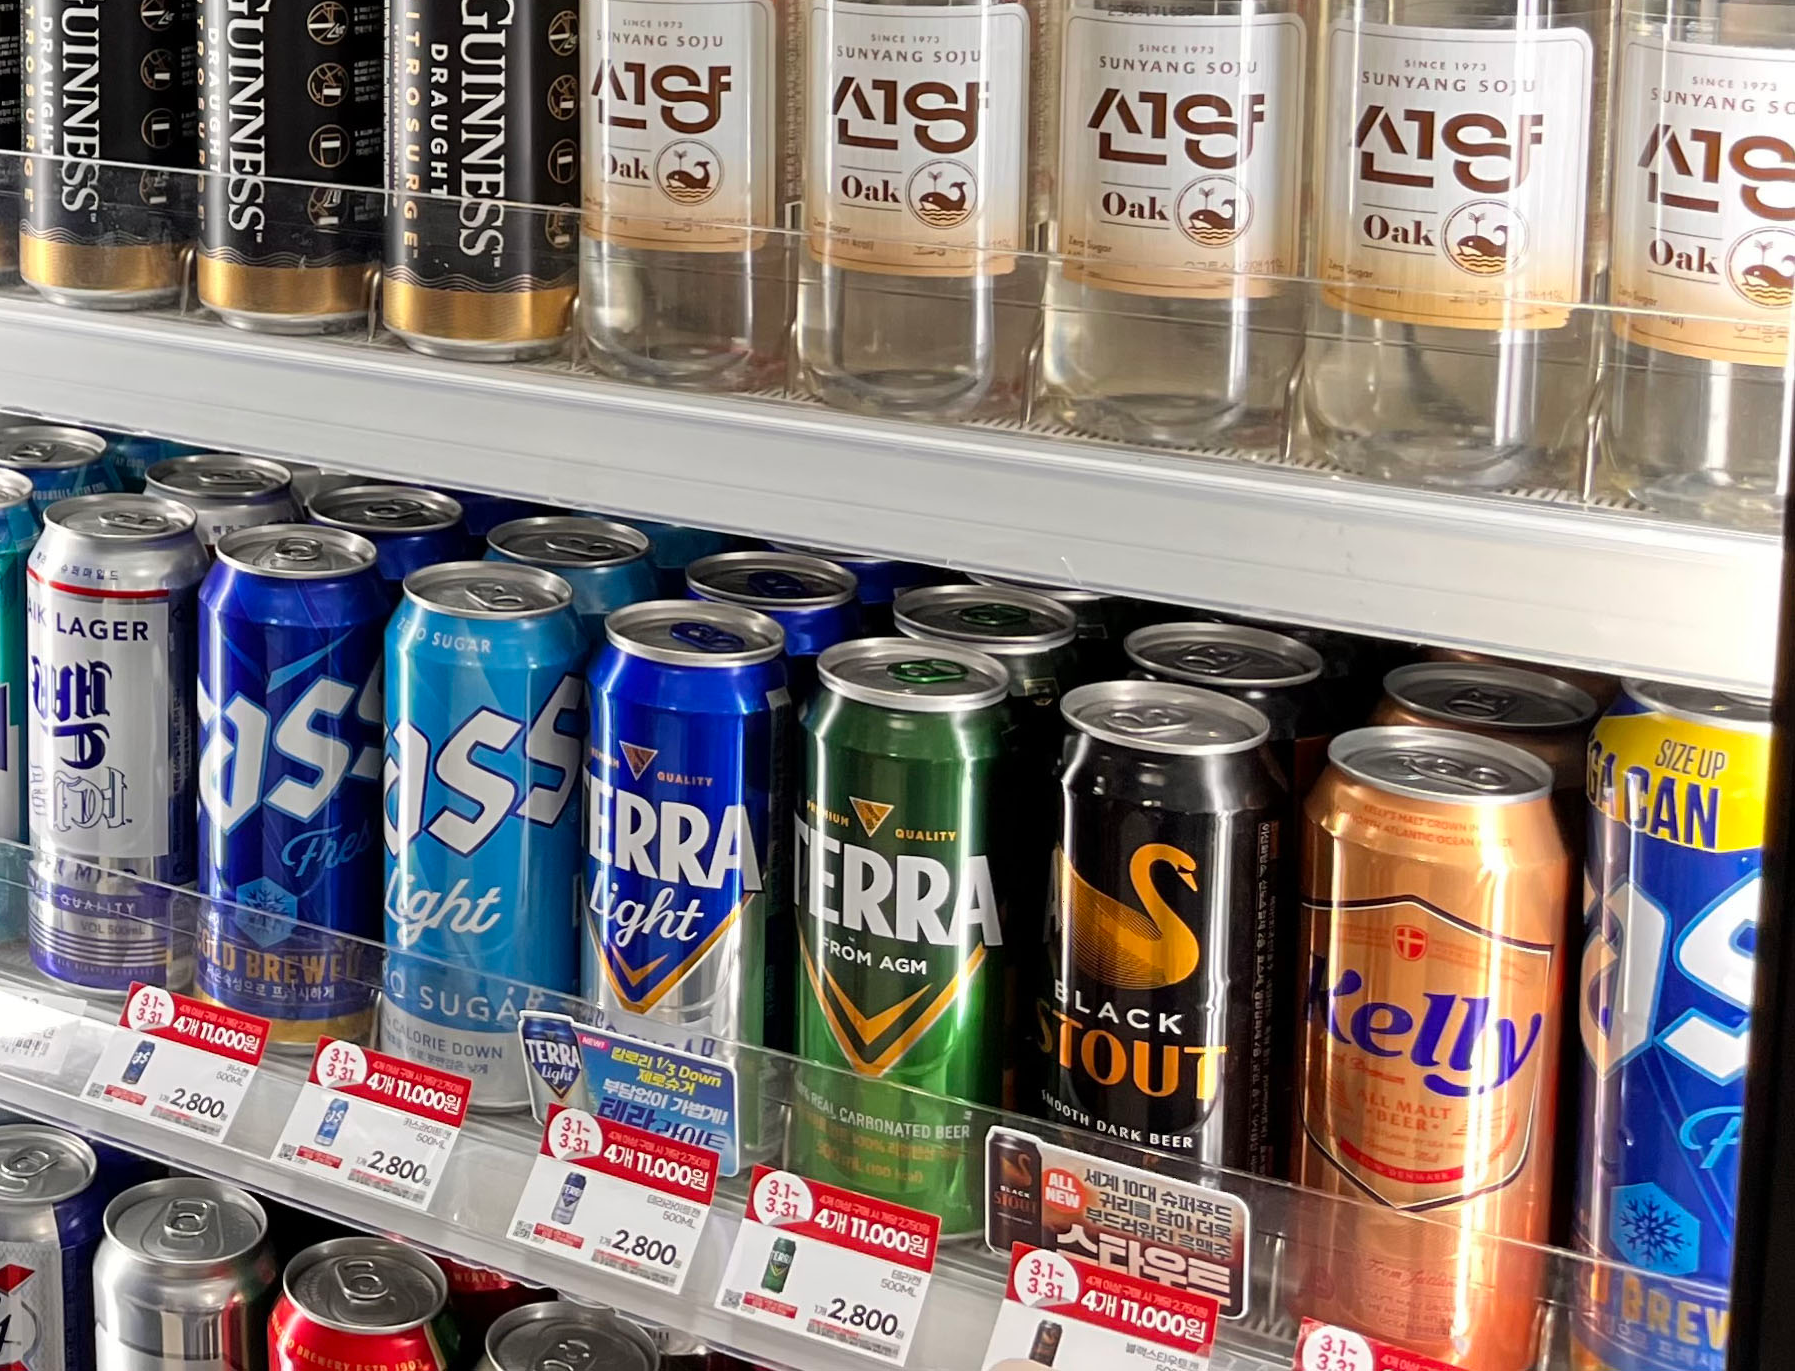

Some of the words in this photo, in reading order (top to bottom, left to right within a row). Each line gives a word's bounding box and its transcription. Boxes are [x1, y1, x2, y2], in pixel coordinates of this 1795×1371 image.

[677, 35, 724, 50] SOJU
[836, 45, 923, 64] SUNYANG
[934, 49, 982, 64] SOJU
[1138, 44, 1177, 54] SINCE
[1184, 45, 1215, 55] 1973
[1099, 56, 1196, 75] SUNYANG
[1206, 59, 1258, 75] SOJU
[1361, 71, 1466, 93] SUNYANG
[1478, 78, 1536, 95] SOJU
[39, 14, 54, 160] DRAUGHT
[591, 59, 732, 133] 선양
[430, 42, 449, 197] DRAUGHT
[833, 76, 990, 155] 선양
[1087, 88, 1265, 170] 선양
[1354, 104, 1543, 194] 선양
[841, 175, 902, 204] Oak
[1102, 191, 1168, 221] Oak
[1364, 214, 1435, 248] Oak
[1648, 238, 1719, 274] Oak
[57, 618, 149, 642] LAGER
[431, 630, 491, 654] SUGAR
[1656, 739, 1695, 773] SIZE
[1698, 749, 1727, 778] UP
[657, 771, 714, 786] QUALITY
[1628, 767, 1719, 850] CAN
[895, 827, 956, 842] QUALITY
[794, 822, 1004, 949] TERRA
[385, 867, 501, 945] Light
[591, 877, 704, 947] Light
[820, 939, 872, 968] FROM
[879, 955, 927, 975] AGM
[136, 1005, 163, 1025] 3.31
[1054, 979, 1183, 1036] BLACK
[1306, 955, 1543, 1096] Kelly
[172, 1014, 198, 1036] 4개
[201, 1024, 261, 1055] 11,000원
[452, 1040, 504, 1060] DOWN
[1036, 996, 1227, 1100] STOUT
[326, 1062, 355, 1082] 3.31
[525, 1039, 581, 1069] TERRA
[611, 1046, 653, 1070] 칼로리
[679, 1065, 721, 1089] Down
[542, 1065, 574, 1084] Light
[636, 1069, 696, 1096] 제로슈거
[366, 1071, 394, 1092] 4개
[395, 1079, 461, 1115] 11,000원
[603, 1078, 668, 1107] 부담없이
[674, 1098, 728, 1126] 가볍게!
[1357, 1087, 1387, 1110] ALL
[1392, 1094, 1452, 1120] MALT
[840, 1105, 929, 1139] CARBONATED
[933, 1123, 970, 1139] BEER
[1041, 1087, 1089, 1128] SMOOTH
[1097, 1117, 1141, 1143] DARK
[1149, 1131, 1193, 1149] BEER
[559, 1133, 589, 1154] 3.31
[603, 1144, 632, 1169] 4개
[637, 1151, 708, 1191] 11,000원
[1048, 1174, 1077, 1193] ALL
[766, 1196, 799, 1217] 3.31
[1044, 1187, 1079, 1209] NEW
[1084, 1167, 1117, 1192] 세계
[1121, 1178, 1156, 1199] 10대
[1161, 1187, 1232, 1218] 슈퍼푸드
[815, 1207, 847, 1232] 4개
[850, 1216, 928, 1257] 11,000원
[1087, 1206, 1171, 1245] 부드러워진
[1179, 1231, 1232, 1260] 흑맥주
[1100, 1190, 1148, 1219] 귀리를
[1154, 1202, 1192, 1228] 담아
[1197, 1215, 1230, 1240] 더욱
[1056, 1223, 1232, 1309] 스타우트
[880, 1279, 916, 1298] 500ML
[1027, 1277, 1063, 1302] 3.31
[1080, 1292, 1117, 1318] 4개
[1120, 1303, 1206, 1343] 11,000원
